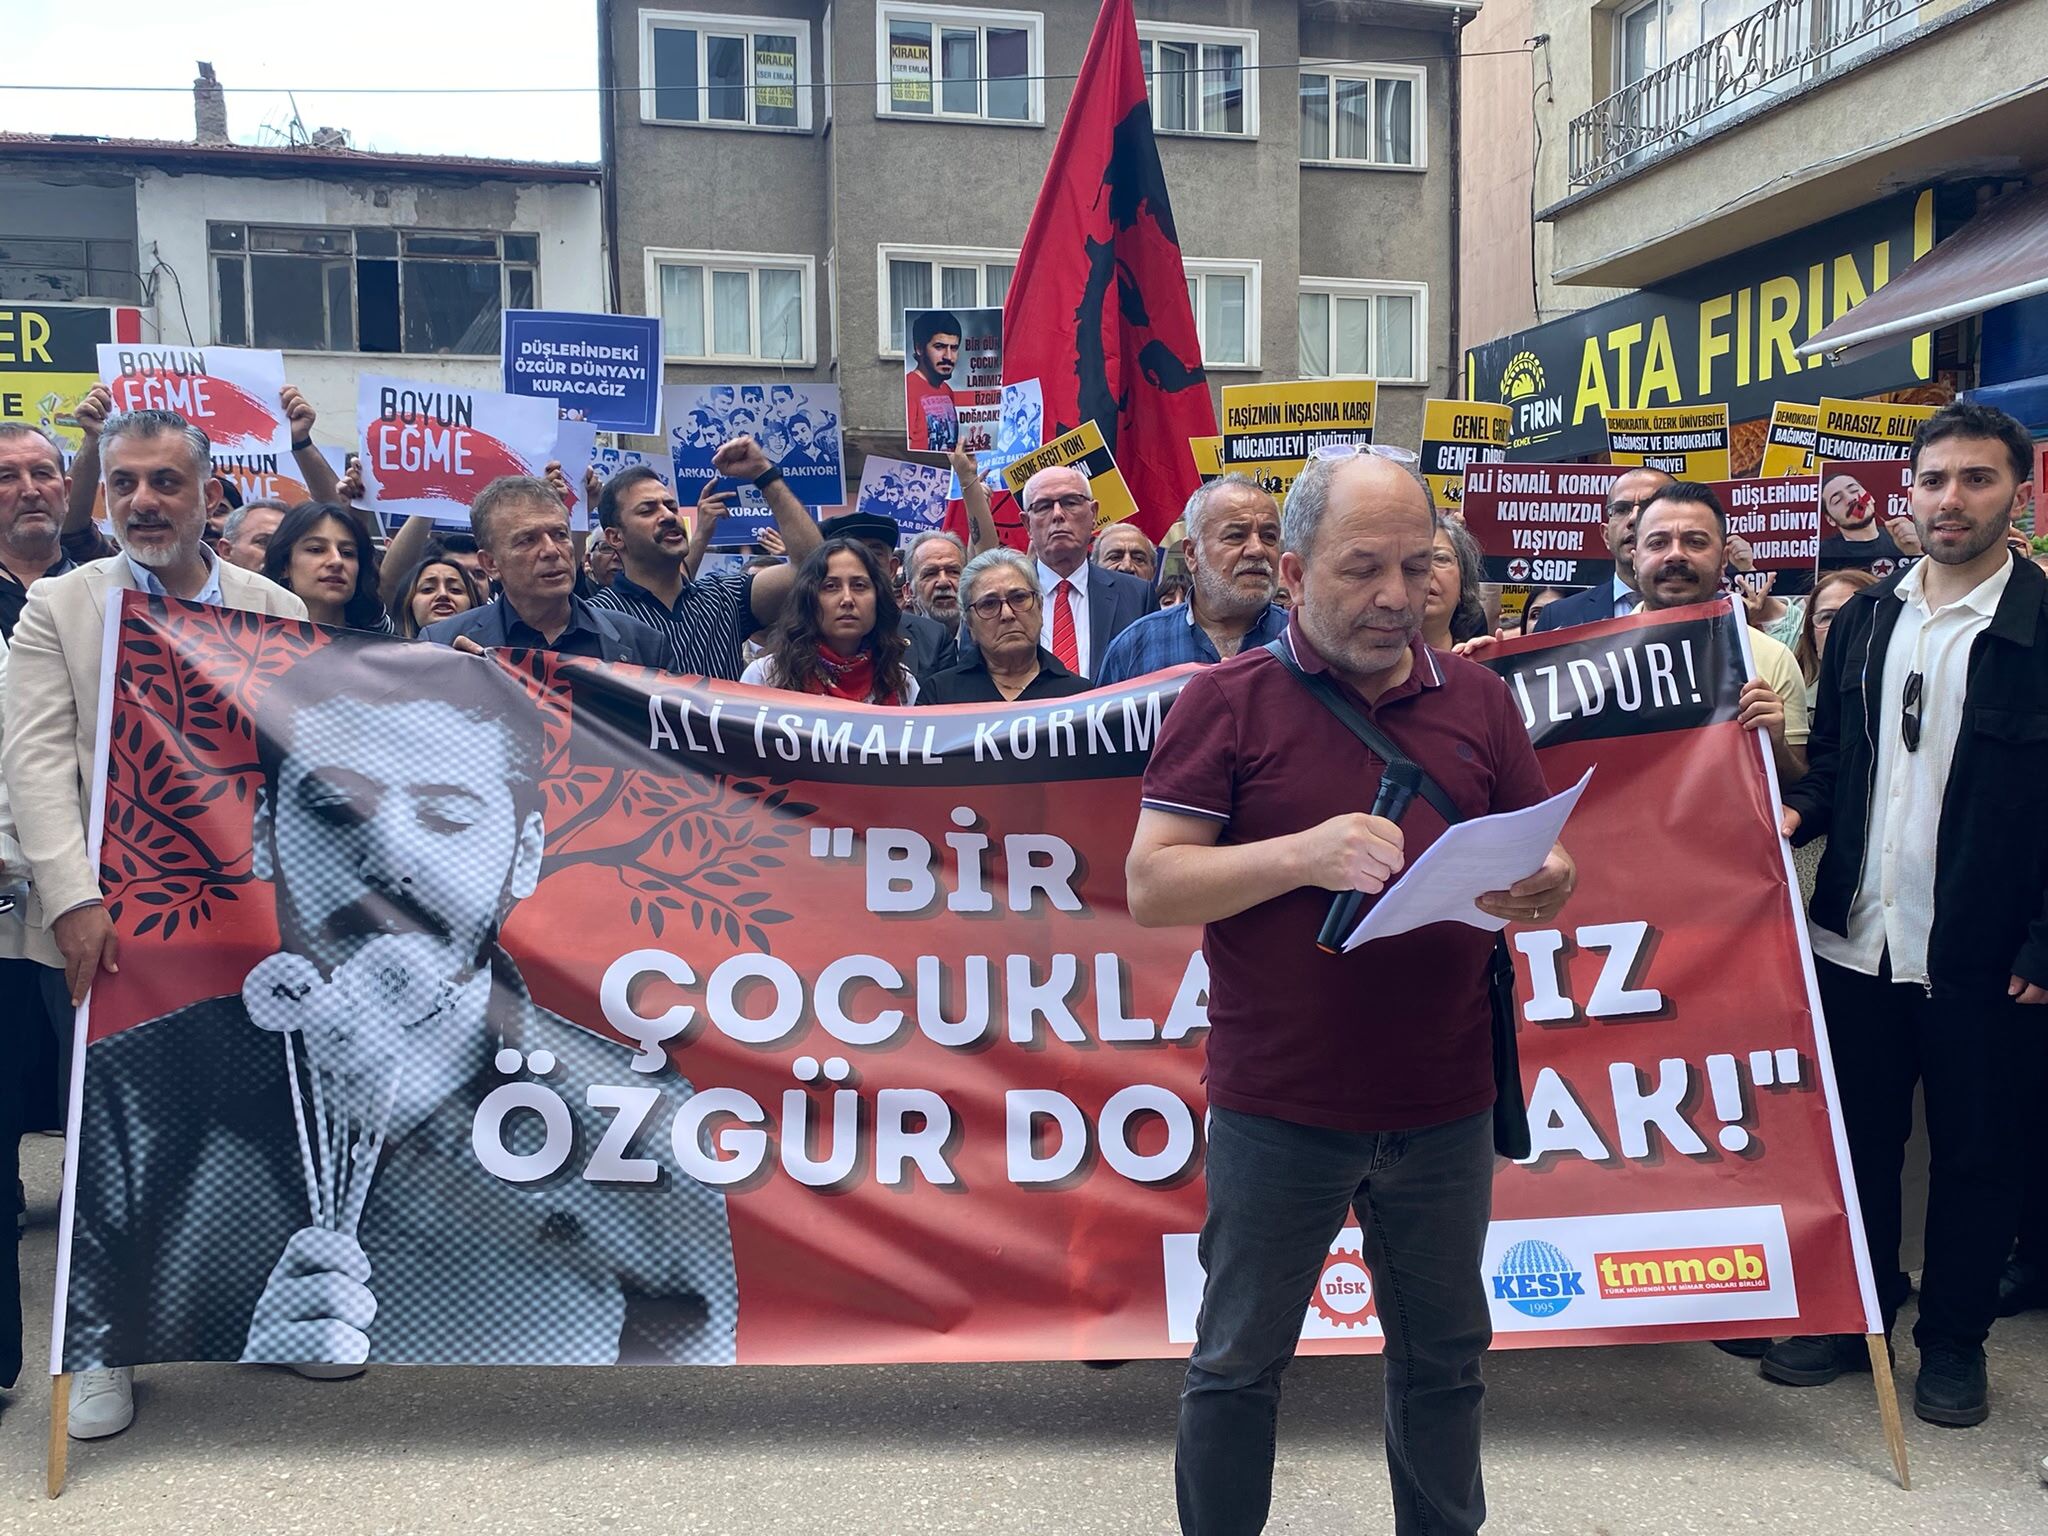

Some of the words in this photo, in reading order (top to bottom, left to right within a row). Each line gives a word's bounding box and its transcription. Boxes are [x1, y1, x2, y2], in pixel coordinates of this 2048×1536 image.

[756, 53, 793, 67] KİRALIK
[891, 46, 929, 60] KİRALIK
[521, 340, 639, 361] DÜŞLERİNDEKİ
[118, 351, 207, 378] BOYUN
[515, 357, 567, 375] ÖZGÜR
[570, 361, 645, 380] DÜNYAYI
[1572, 314, 1682, 426] ATA
[123, 376, 216, 418] EĞME
[532, 378, 626, 397] KURACAĞIZ
[380, 386, 473, 428] BOYUN
[1228, 403, 1281, 430] FAŞİZMİN
[1284, 401, 1339, 427] İNŞASINA
[1342, 401, 1371, 425] KARŞI
[1520, 395, 1562, 433] FIRIN
[1453, 414, 1490, 440] GENEL
[1608, 418, 1652, 431] DEMOKRATİK,
[1653, 416, 1677, 430] ÖZERK
[1679, 412, 1725, 429] ÜNİVERSİTE
[1827, 411, 1883, 437] PARASIZ,
[1061, 434, 1087, 458] YOK!
[1232, 432, 1304, 459] MÜCADELEYİ
[1612, 434, 1649, 451] BAĞIMSIZ
[1650, 436, 1662, 450] VE
[1663, 430, 1722, 450] DEMOKRATİK
[1774, 427, 1816, 446] BAĞIMSIZ
[1818, 436, 1899, 460] DEMOKRATİK
[379, 424, 475, 476] EĞME
[1437, 445, 1478, 471] GENEL
[782, 465, 838, 477] BAKIYOR!
[1644, 456, 1684, 473] TÜRKİYE!
[1467, 469, 1493, 493] ALİ
[1496, 469, 1553, 494] İSMAİL
[1731, 482, 1818, 510] DÜŞLERİNDE
[1497, 501, 1602, 523] KAVGAMIZDA
[1770, 510, 1817, 531] DÜNYA
[1512, 529, 1585, 556] YAŞIYOR!
[1531, 559, 1577, 582] SGDF
[648, 694, 726, 755] ALİ
[753, 705, 944, 766] İSMAİL
[809, 806, 1083, 914] "BİR
[472, 1048, 956, 1187] ÖZGÜR
[1005, 1084, 1212, 1183] DO
[1600, 1248, 1764, 1288] tmmob
[1325, 1276, 1367, 1296] DİSK
[1492, 1271, 1586, 1299] KESK
[1604, 1287, 1625, 1296] TÜRK
[1626, 1285, 1665, 1294] MÜHENDİS
[1679, 1283, 1704, 1291] MİMAR
[1705, 1281, 1738, 1290] ODALARI
[1739, 1279, 1766, 1288] BİRLİĞİ
[1528, 1302, 1555, 1314] 1995
